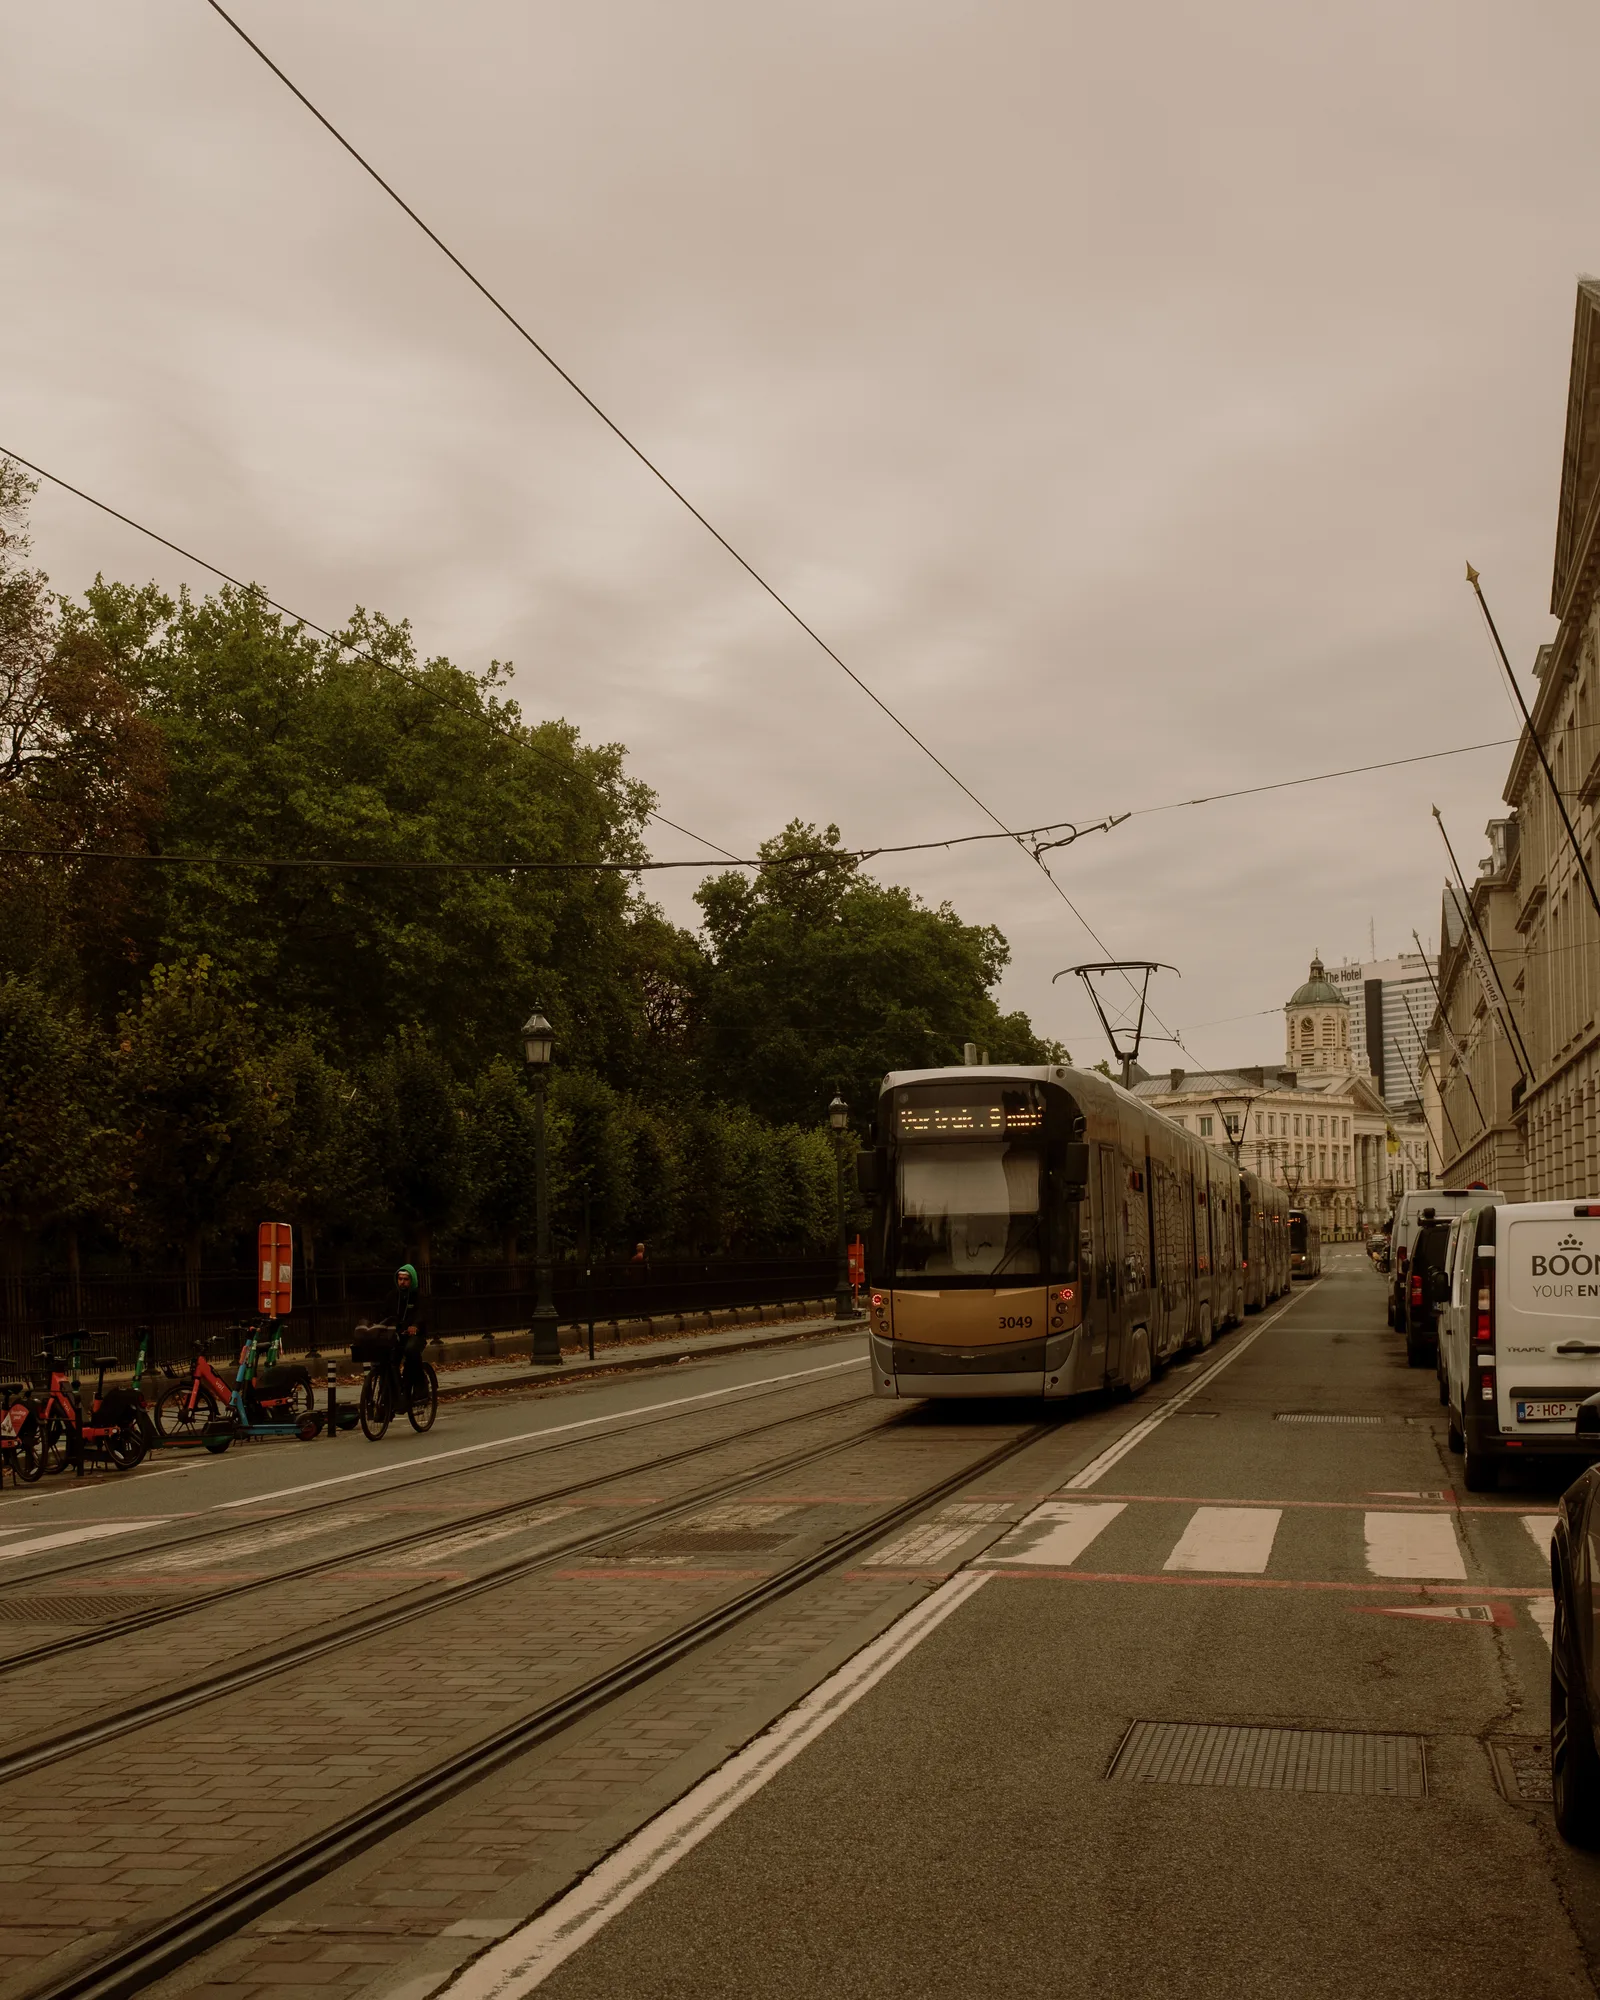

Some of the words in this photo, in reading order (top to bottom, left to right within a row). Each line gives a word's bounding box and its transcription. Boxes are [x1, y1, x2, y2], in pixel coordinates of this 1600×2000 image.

[1324, 972, 1339, 983] The
[1341, 968, 1361, 982] Hotel
[1532, 1284, 1573, 1298] YOUR
[1578, 1284, 1600, 1297] EN
[999, 1316, 1033, 1329] 3049
